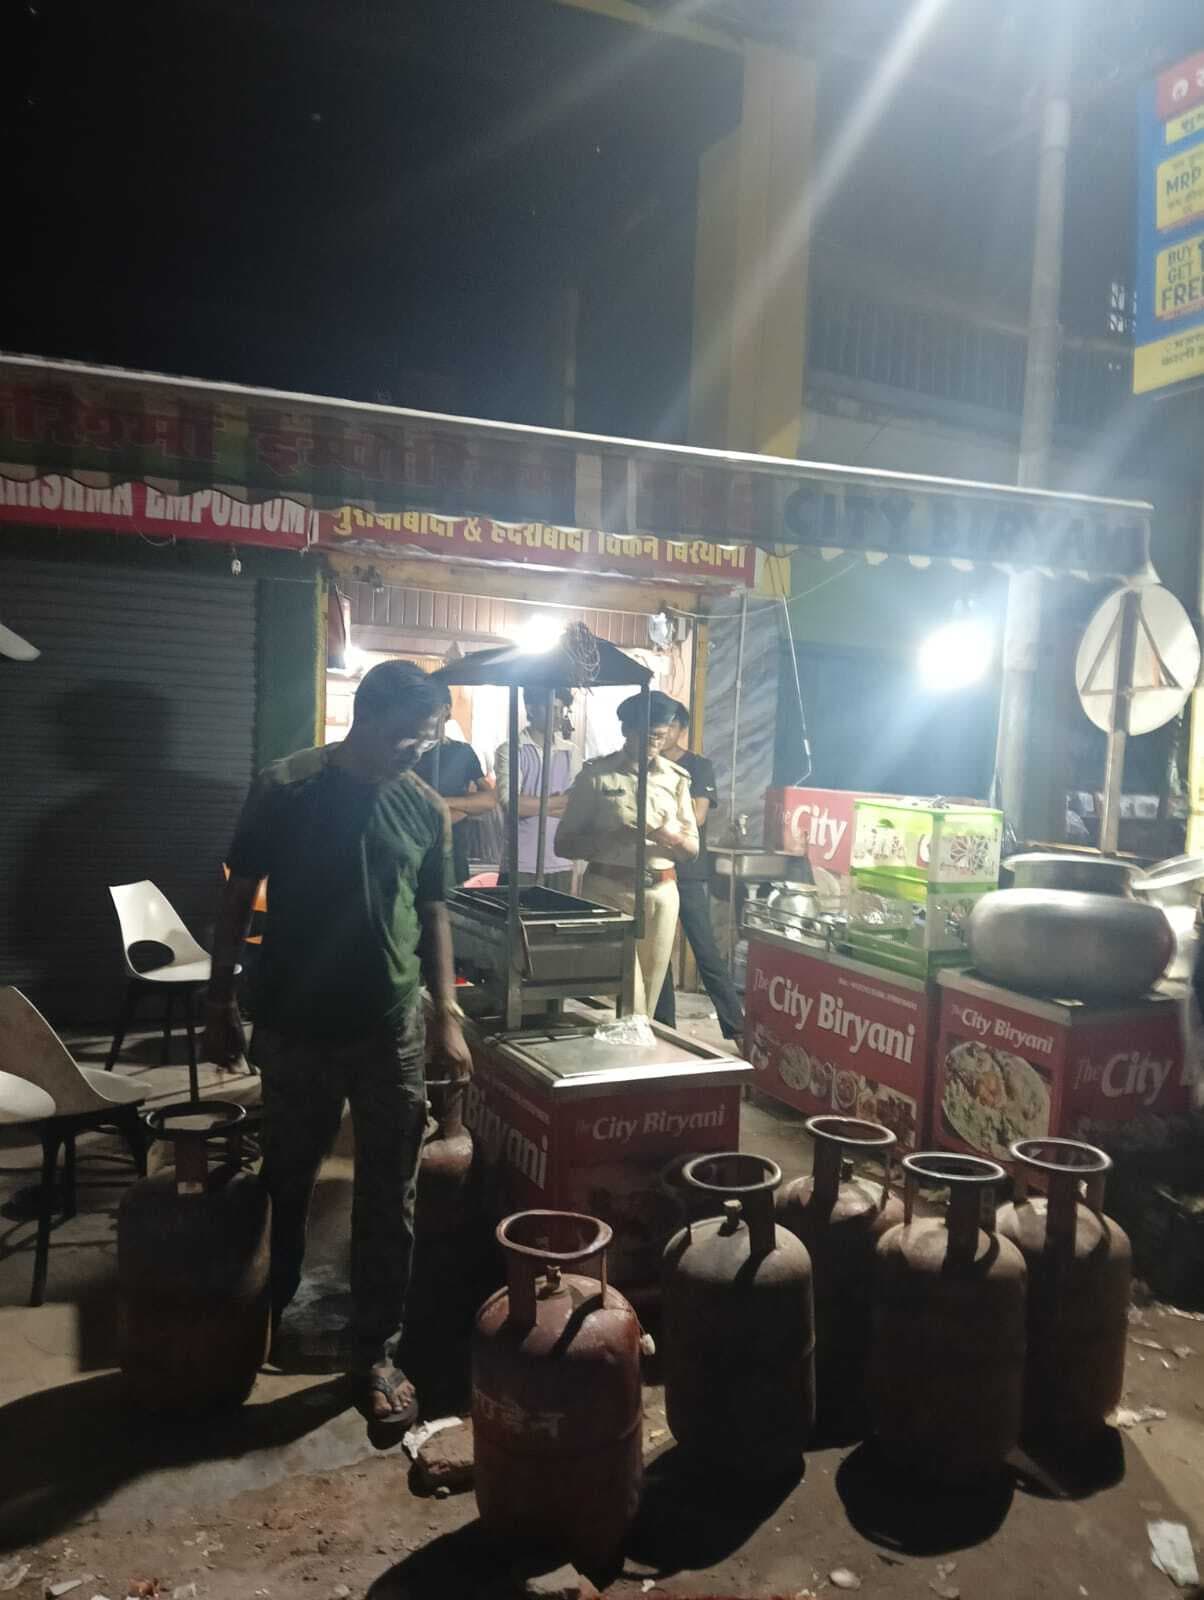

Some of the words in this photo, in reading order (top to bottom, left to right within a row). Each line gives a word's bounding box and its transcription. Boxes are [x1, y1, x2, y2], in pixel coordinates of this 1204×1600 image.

[1165, 166, 1202, 193] MRP
[1167, 246, 1193, 267] BUY
[1167, 263, 1193, 285] GET
[1161, 275, 1204, 311] FRE
[0, 473, 133, 516] RISHMA
[463, 516, 483, 543] &
[790, 803, 849, 860] City
[768, 975, 814, 1031] City
[816, 991, 916, 1064] Biryani
[961, 1008, 993, 1036] City
[993, 1018, 1054, 1054] Biryani
[1101, 1051, 1174, 1106] City
[591, 1112, 639, 1144] City
[642, 1104, 726, 1137] Biryani
